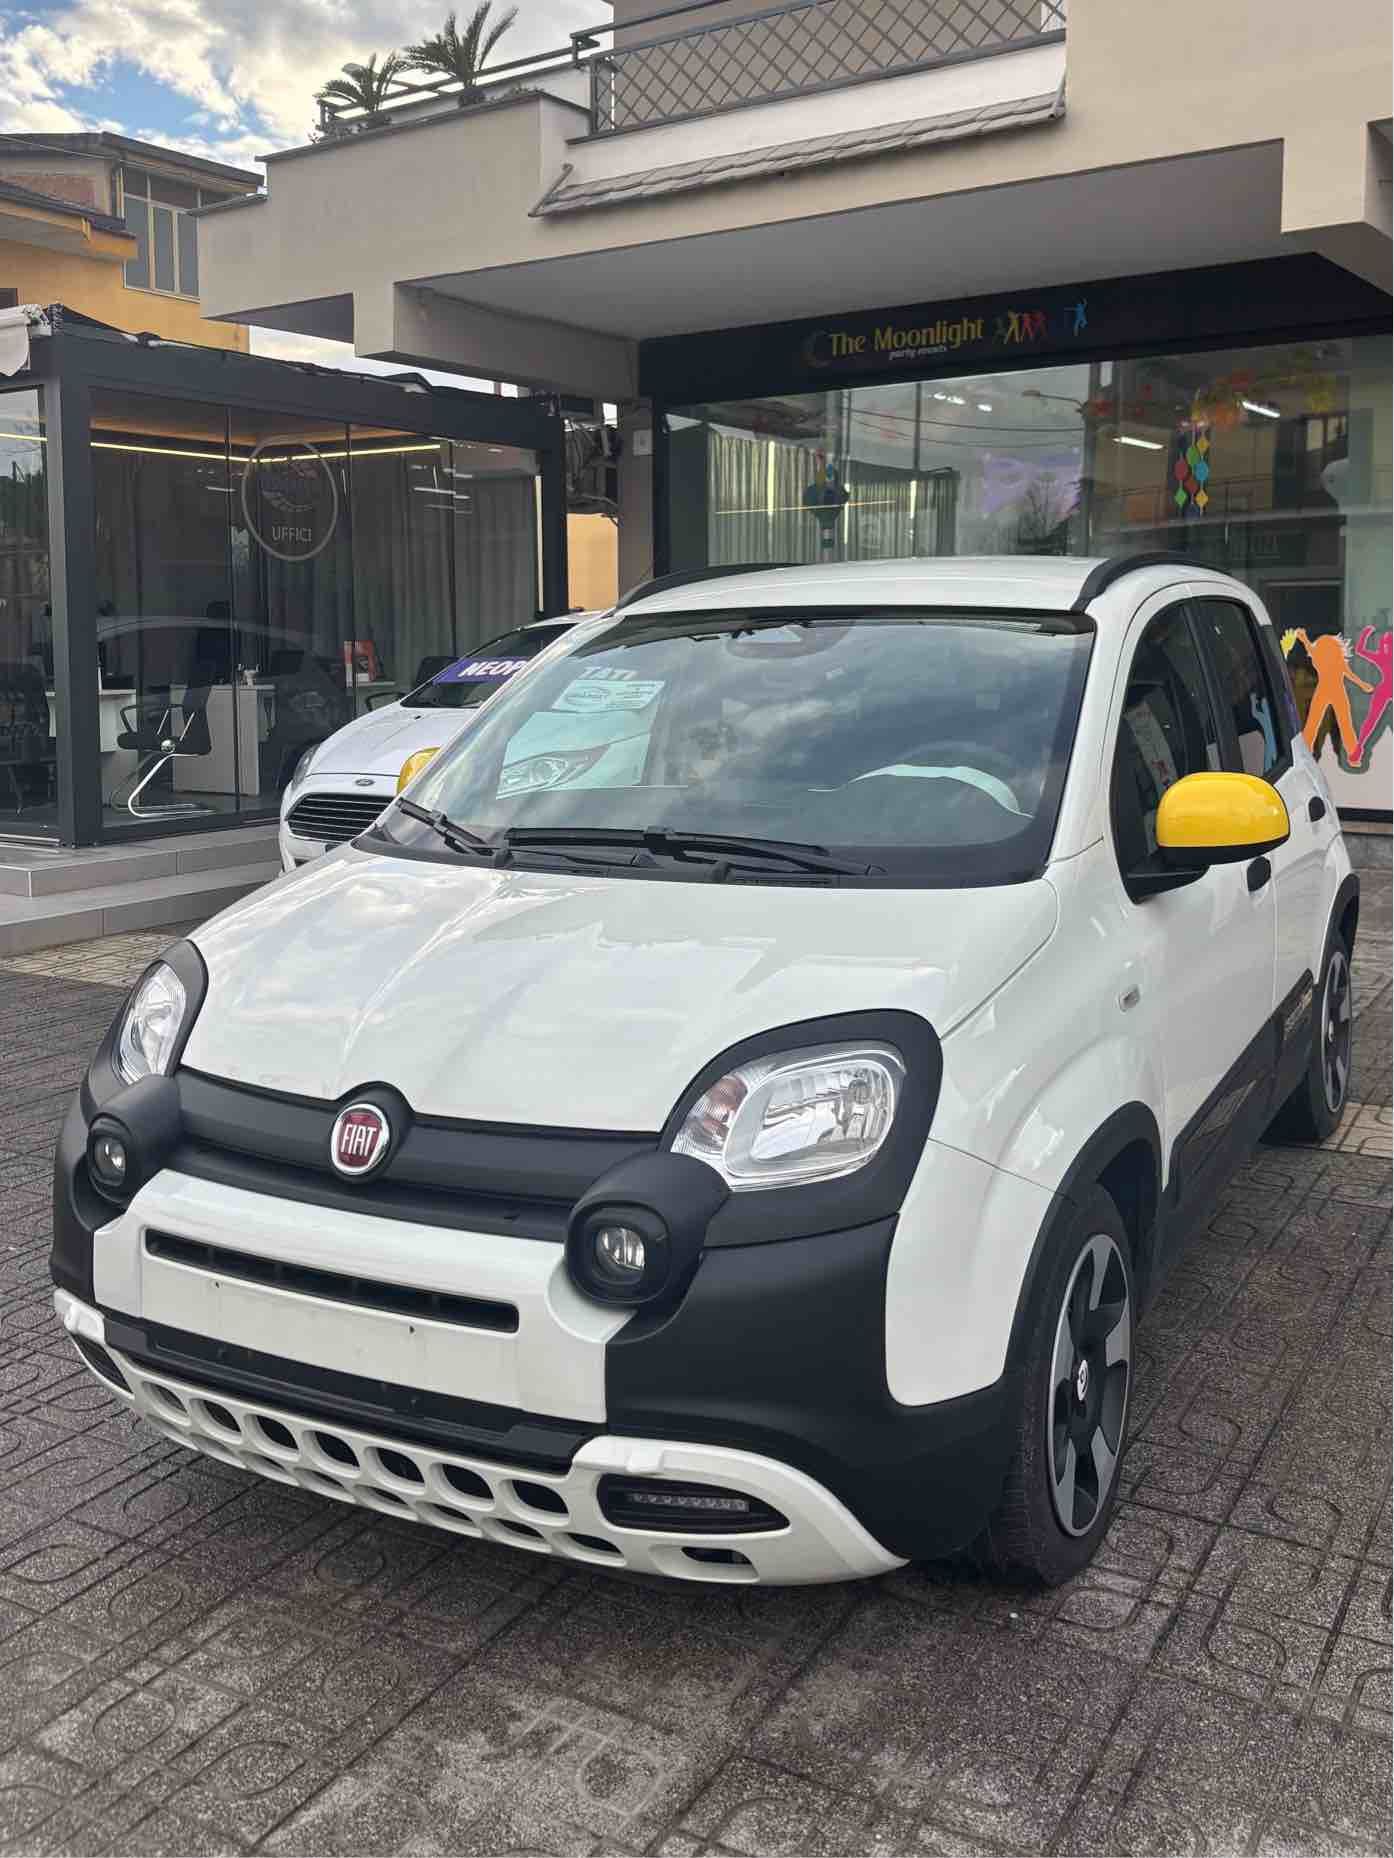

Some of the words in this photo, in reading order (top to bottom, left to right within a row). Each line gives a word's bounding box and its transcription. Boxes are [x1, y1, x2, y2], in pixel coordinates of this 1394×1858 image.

[830, 333, 866, 356] The
[874, 318, 985, 351] Moonlight
[271, 526, 312, 542] UFFICI
[457, 660, 528, 678] NEOP
[340, 1123, 377, 1157] FIAT
